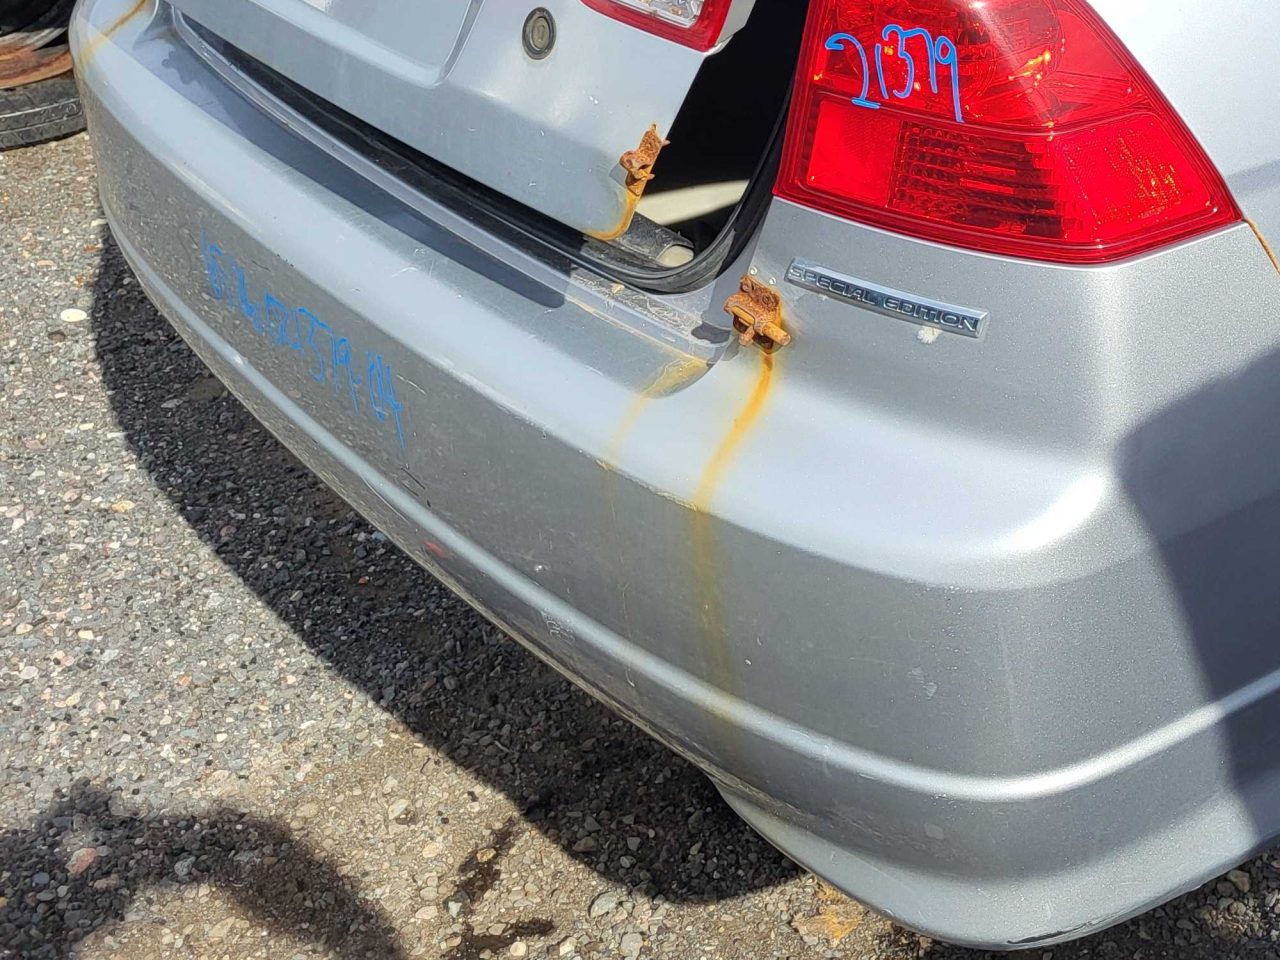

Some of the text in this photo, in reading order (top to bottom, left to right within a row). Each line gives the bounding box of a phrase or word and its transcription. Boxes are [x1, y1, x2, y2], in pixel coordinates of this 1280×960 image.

[824, 24, 966, 123] 21379
[789, 266, 979, 333] SPECIAL EDITION
